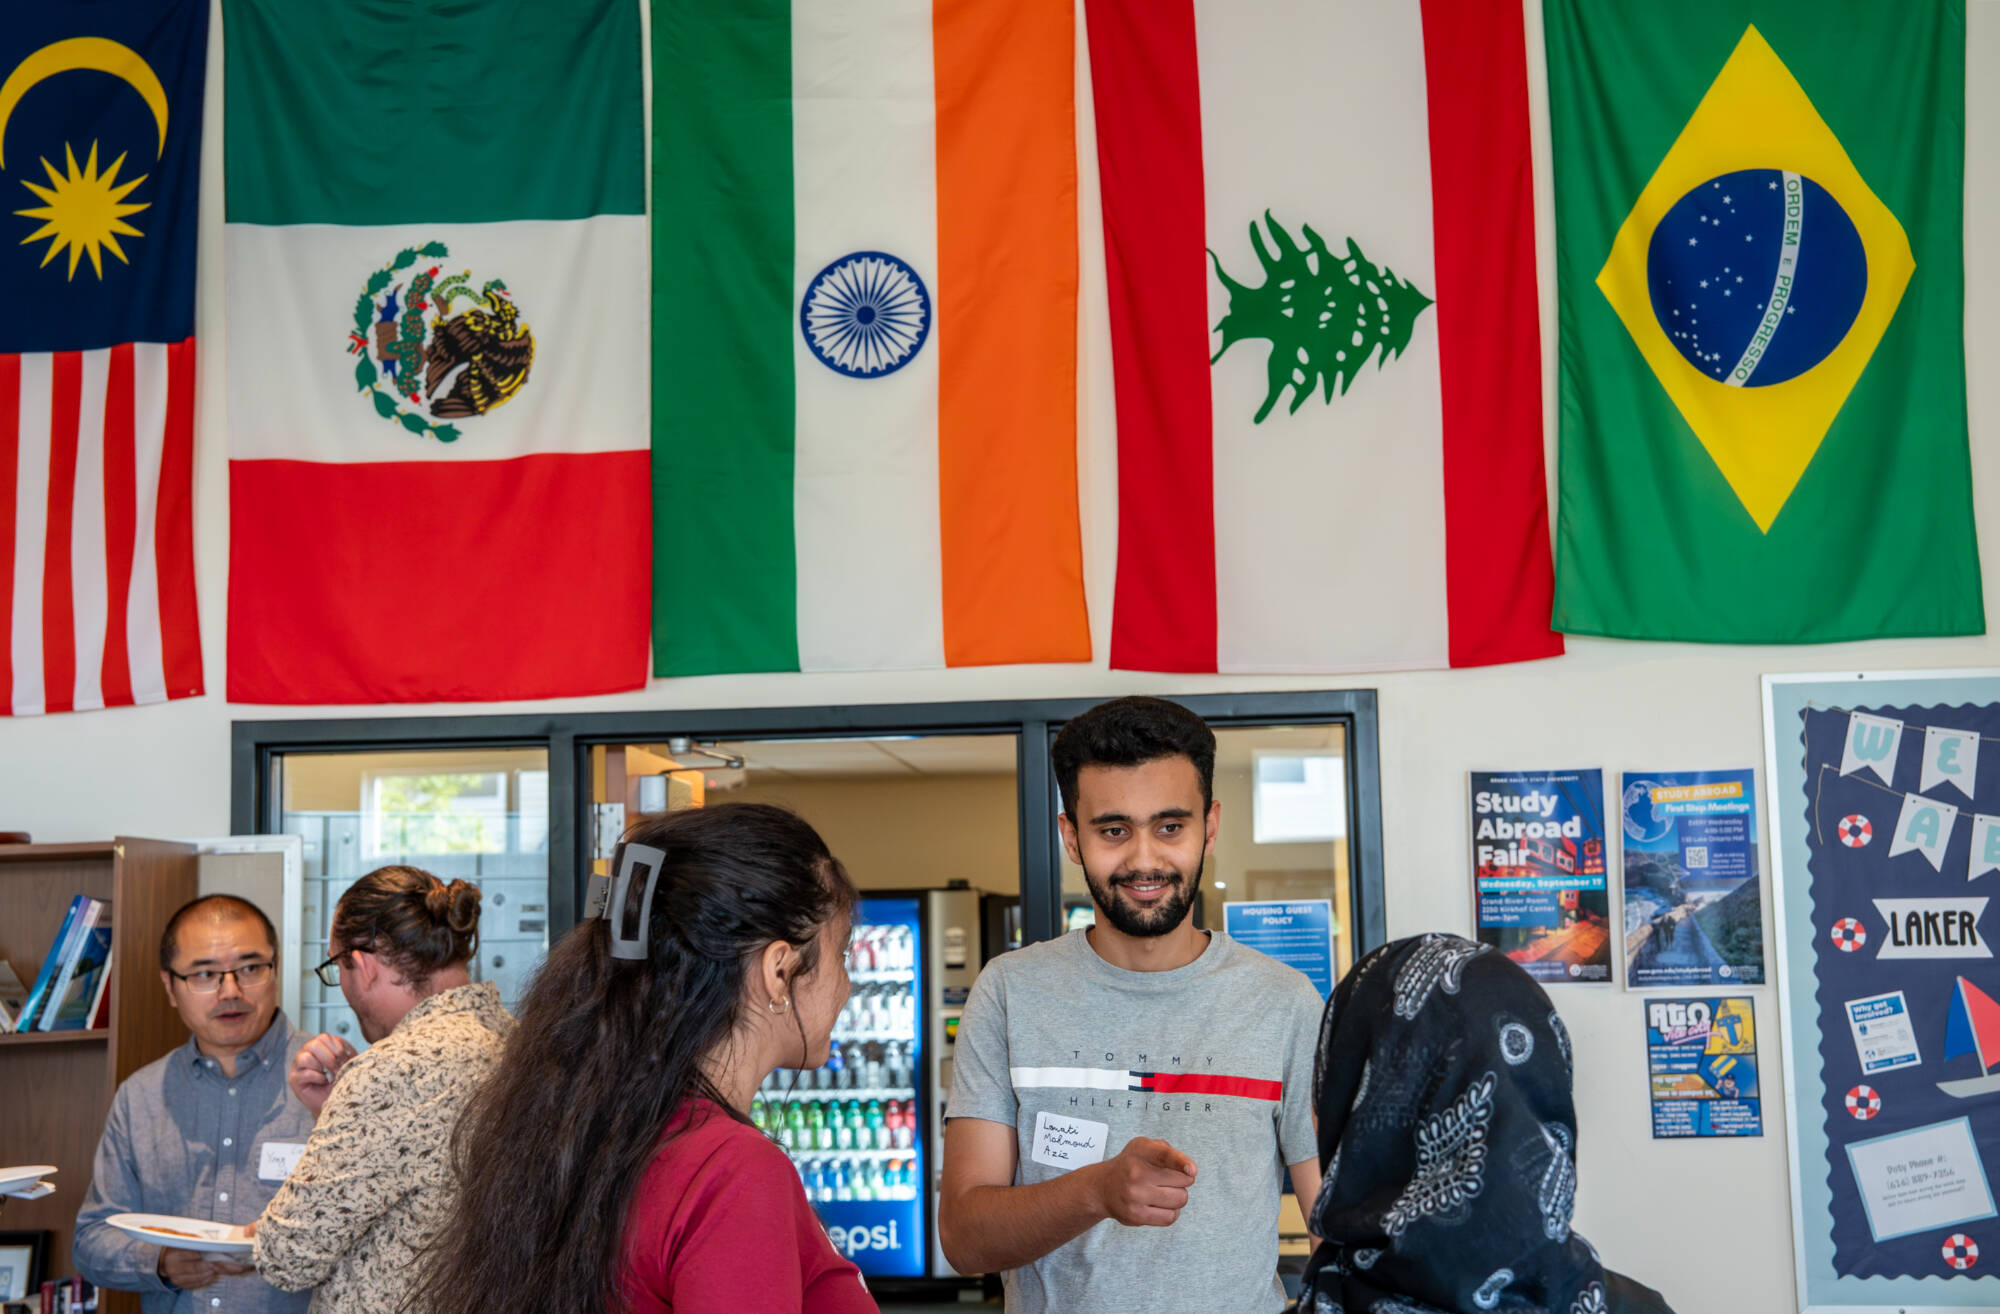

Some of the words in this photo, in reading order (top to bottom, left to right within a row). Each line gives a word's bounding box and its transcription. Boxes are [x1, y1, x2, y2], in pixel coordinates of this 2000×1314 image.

[1784, 179, 1800, 246] ORDEM
[1782, 257, 1793, 266] E
[1735, 274, 1792, 380] PROGRESSO
[1656, 788, 1690, 800] STUDY
[1694, 785, 1737, 797] ABROAD
[1475, 790, 1559, 817] Study
[1665, 803, 1684, 812] First
[1708, 801, 1750, 813] Meetings
[1476, 815, 1581, 840] Abroad
[1478, 842, 1531, 867] Fair
[1480, 879, 1536, 889] Wednesday,
[1537, 878, 1590, 888] September
[1242, 906, 1284, 916] HOUSING
[1285, 905, 1313, 915] GUEST
[1262, 916, 1294, 925] POLICY
[1890, 911, 1978, 947] LAKER
[1853, 1003, 1872, 1014] Why
[1873, 1001, 1887, 1010] get
[1072, 1050, 1213, 1066] TOMMY
[1069, 1096, 1212, 1112] HILFIGER
[829, 1219, 898, 1257] epsi
